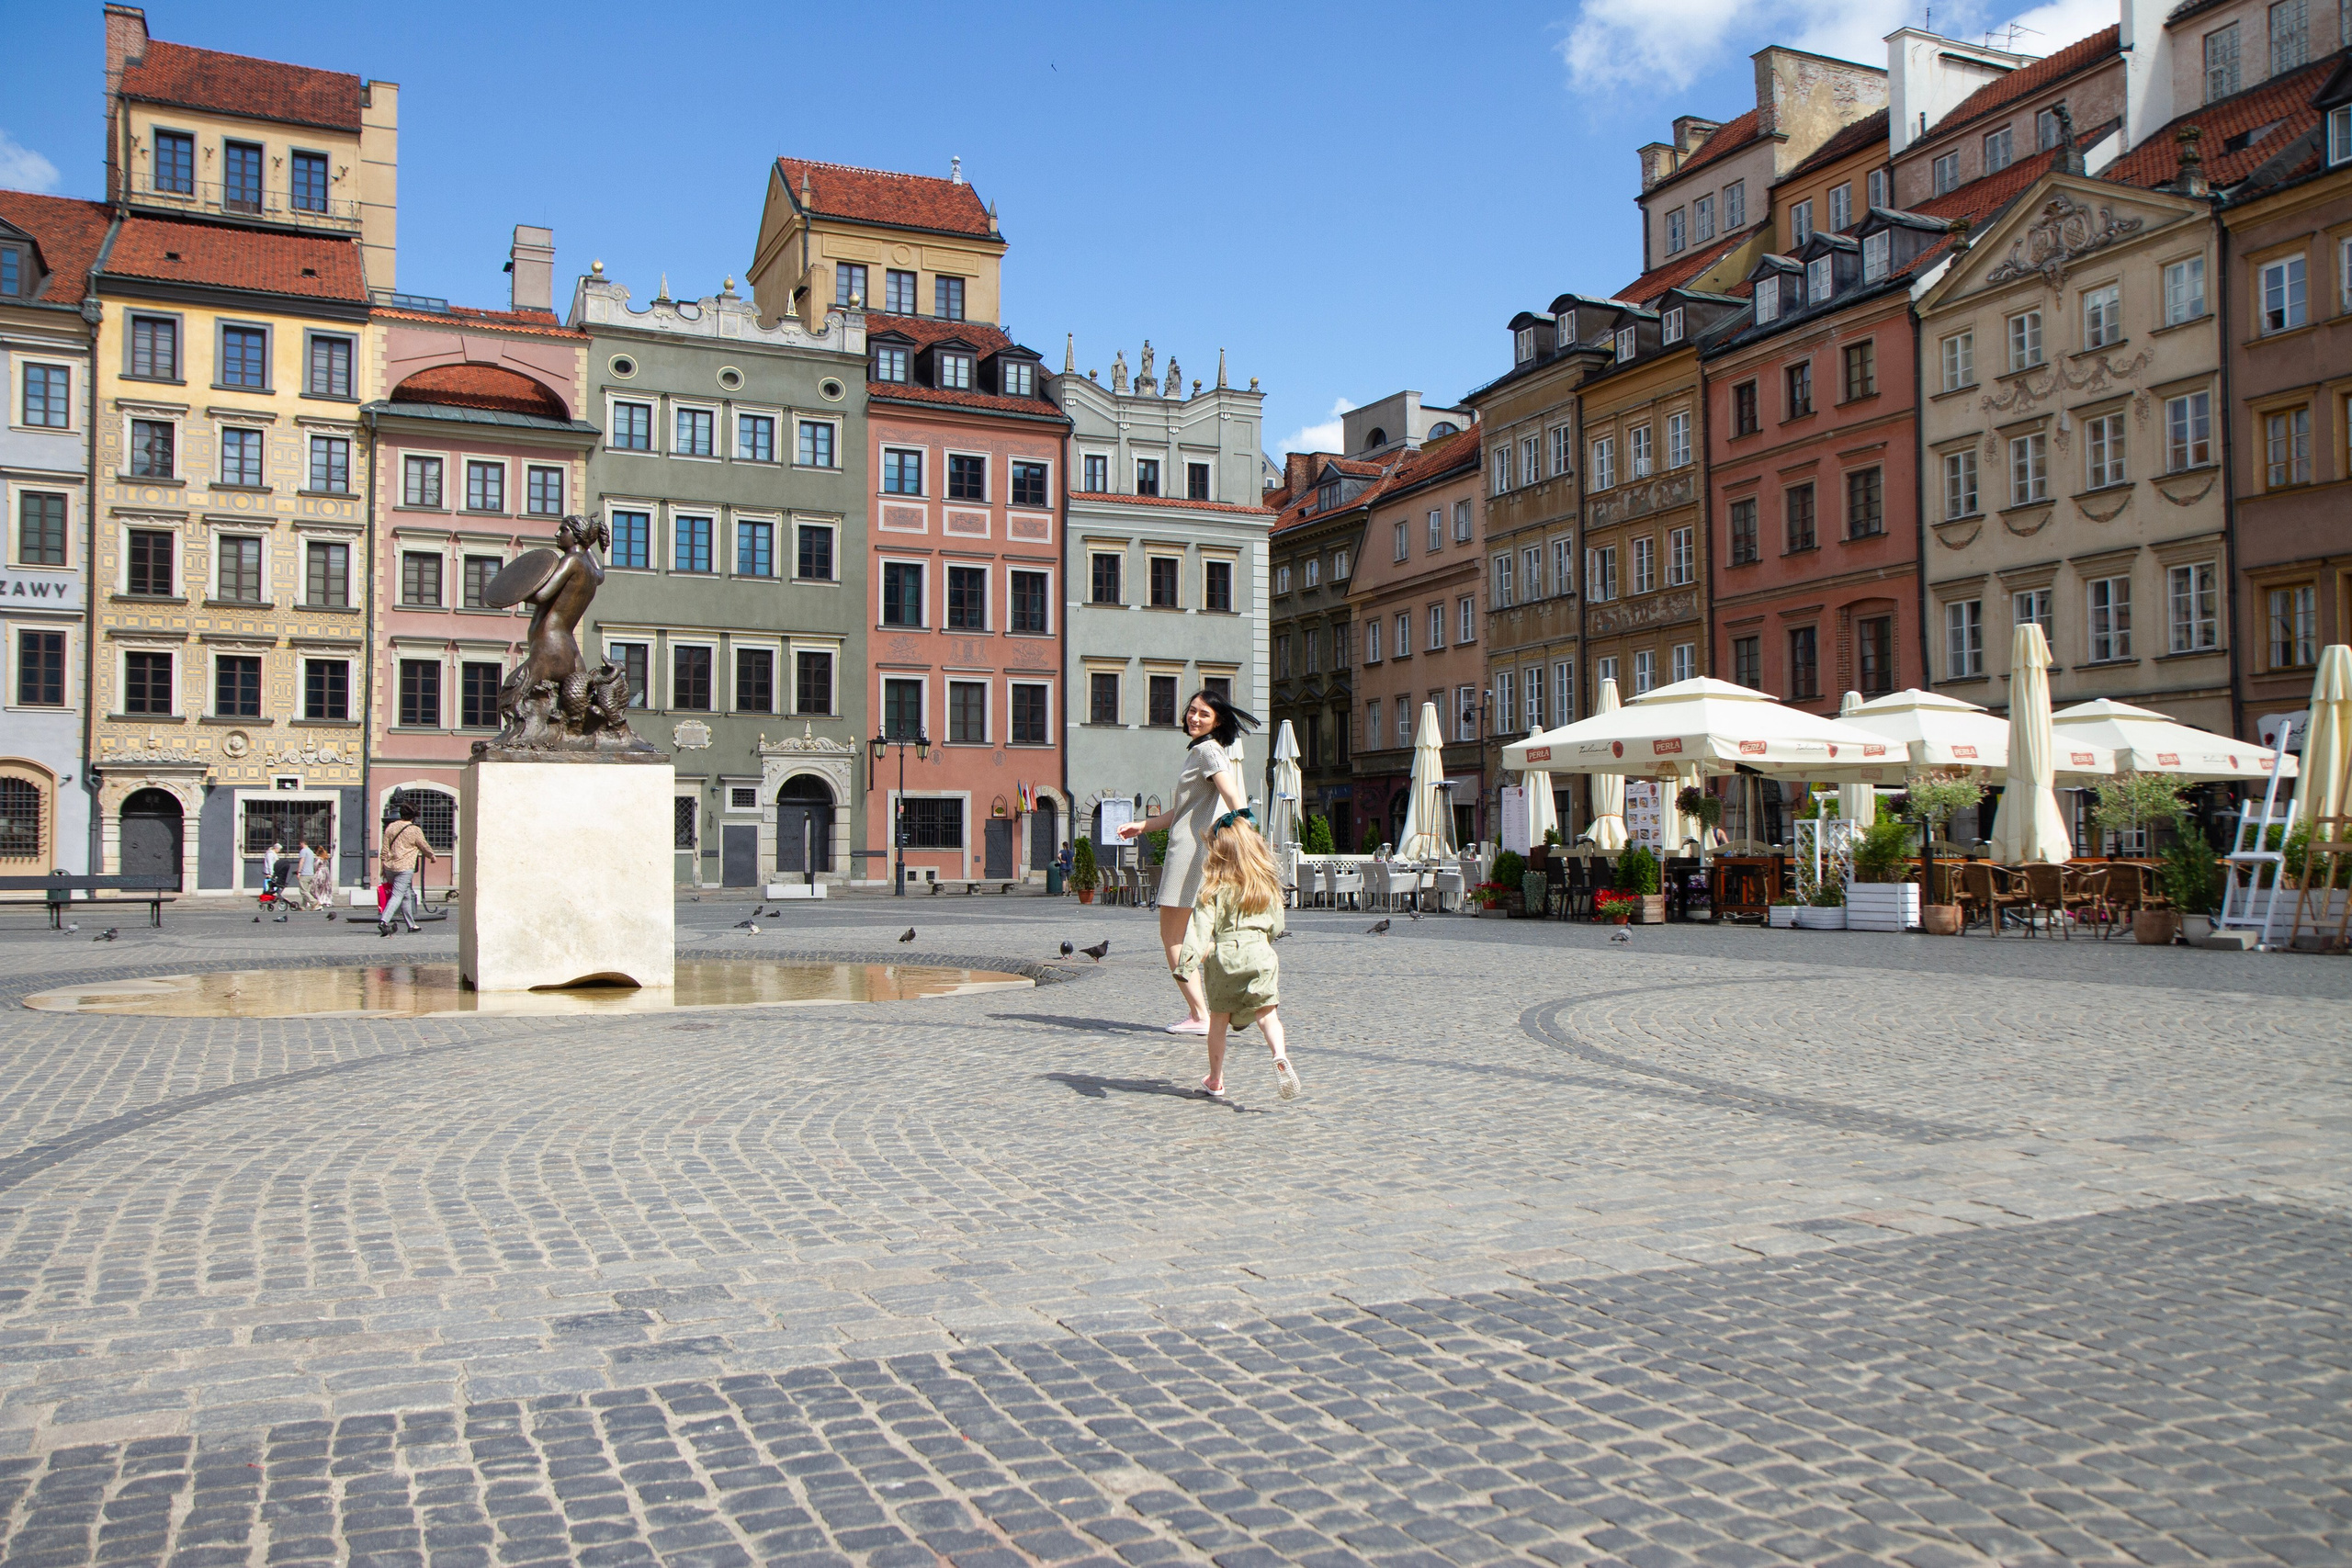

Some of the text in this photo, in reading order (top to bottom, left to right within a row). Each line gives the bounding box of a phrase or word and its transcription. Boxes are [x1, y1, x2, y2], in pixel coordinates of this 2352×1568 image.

[1656, 740, 1680, 752] PERŁA
[1741, 742, 1765, 752] PERŁA
[1529, 749, 1550, 761] PERŁA
